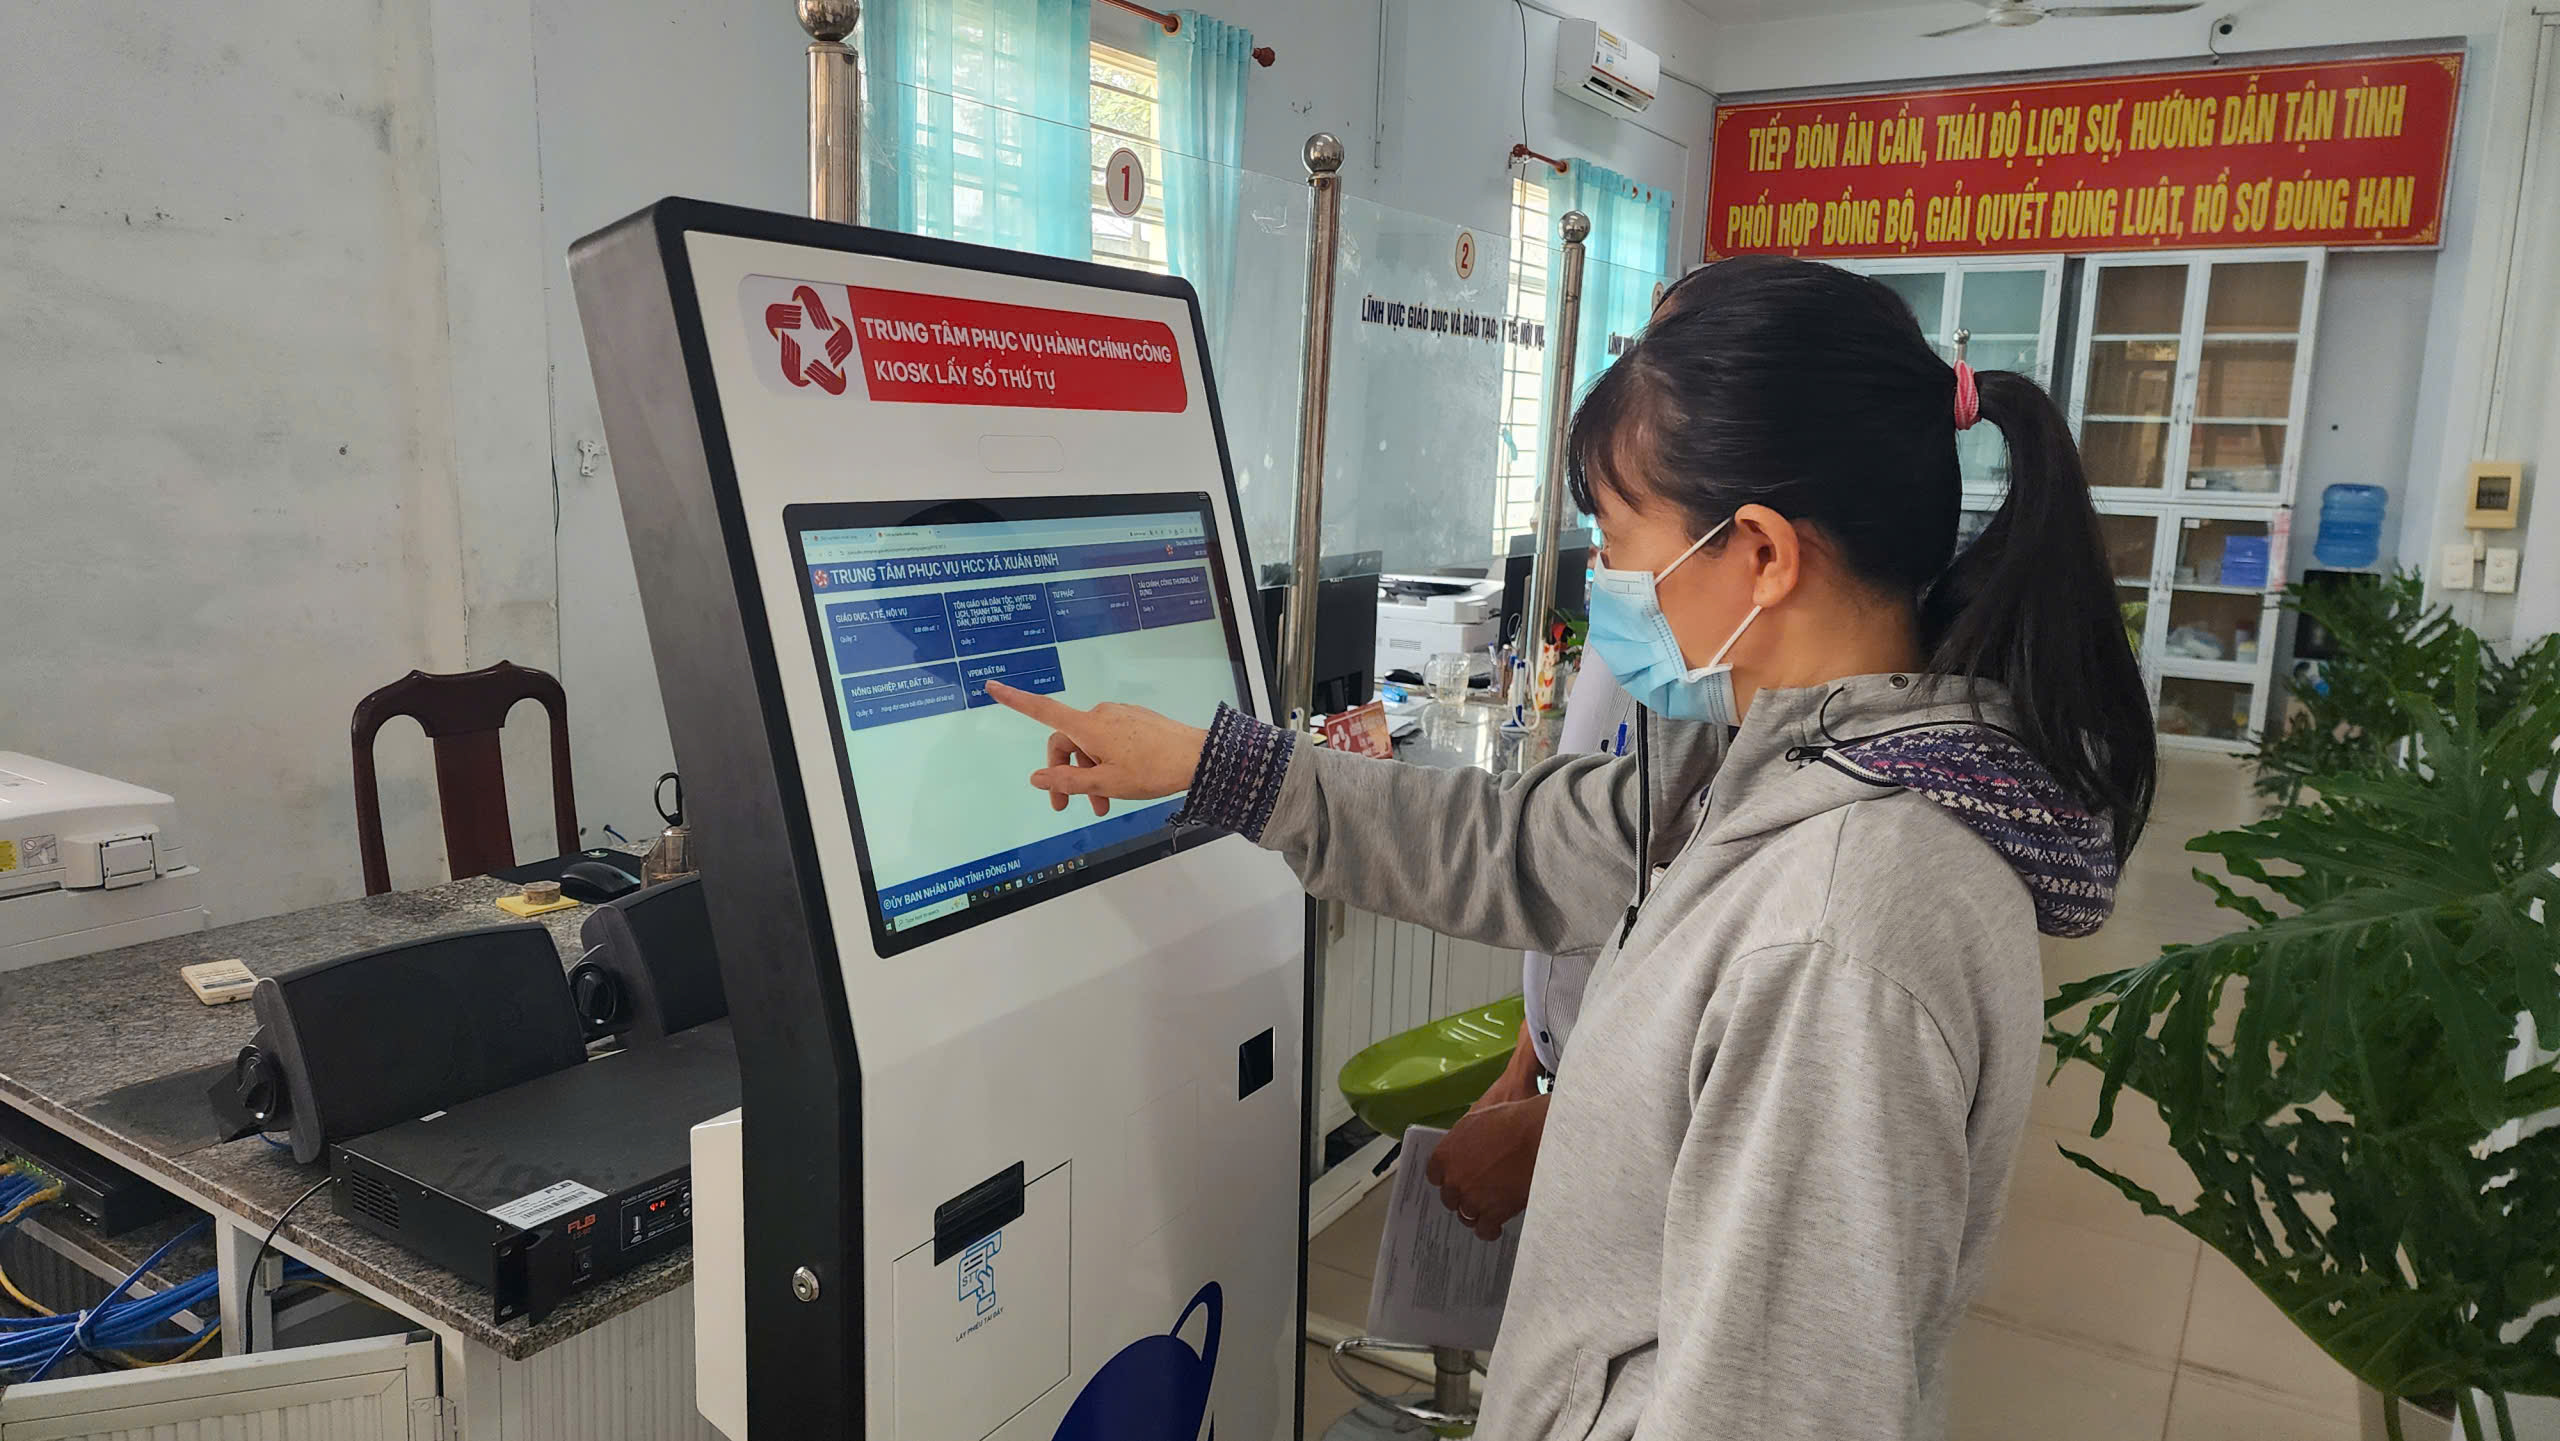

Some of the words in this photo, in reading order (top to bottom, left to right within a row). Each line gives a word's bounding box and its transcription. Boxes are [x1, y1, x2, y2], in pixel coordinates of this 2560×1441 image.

[1749, 112, 1791, 172] TIẾP
[1794, 114, 1839, 169] ĐÓN
[1842, 112, 1874, 166] ÂN
[1878, 101, 1927, 168] CẦN,
[1936, 103, 1986, 161] THÁI
[1989, 100, 2022, 168] ĐỘ
[2025, 106, 2080, 166] LỊCH
[2084, 98, 2123, 163] SỰ,
[2129, 88, 2217, 150] HƯỚNG
[2220, 75, 2278, 146] DẪN
[2284, 80, 2337, 152] TẬN
[2343, 76, 2407, 140] TÌNH
[1121, 164, 1130, 201] 1
[1726, 188, 1774, 248] PHỐI
[1777, 198, 1818, 256] HỢP
[1822, 185, 1880, 246] ĐỒNG
[1884, 188, 1918, 253] BỘ,
[1925, 180, 1971, 242] GIẢI
[1976, 176, 2048, 246] QUYẾT
[2050, 180, 2118, 238] ĐÚNG
[2121, 176, 2184, 246] LUẬT,
[2192, 167, 2230, 234] HỒ
[2232, 178, 2272, 232] SƠ
[2274, 169, 2350, 232] ĐÚNG
[2354, 176, 2415, 240] HẠN
[1462, 242, 1469, 269] 2
[860, 317, 929, 344] TRUNG
[930, 320, 970, 347] TÂM
[971, 328, 1018, 356] PHỤC
[1019, 332, 1042, 358] VỤ
[1044, 331, 1087, 356] HÀNH
[1088, 336, 1132, 360] CHÍNH
[1133, 340, 1172, 363] CÔNG
[1362, 294, 1384, 324] LĨNH
[1387, 301, 1406, 332] VỰC
[1408, 302, 1428, 330] GIÁO
[1430, 310, 1448, 337] DỤC
[1450, 308, 1460, 334] VÀ
[1463, 310, 1480, 336] ĐÀO
[1502, 320, 1506, 342] Y
[1520, 319, 1533, 350] NỘI
[874, 360, 933, 384] KIOSK
[935, 356, 967, 385] LẤY
[972, 359, 996, 387] SỐ
[998, 364, 1032, 389] THỨ
[1033, 370, 1056, 394] TỰ
[830, 567, 876, 584] TRUNG
[877, 562, 906, 581] TÂM
[908, 562, 941, 580] PHỤC
[942, 560, 960, 578] VỤ
[961, 559, 985, 574] HCC
[986, 554, 1002, 572] XÃ
[1004, 553, 1032, 570] XUÂN
[1034, 553, 1059, 570] ĐỊNH
[836, 611, 852, 623] GIÁO
[853, 612, 870, 622] DỤC,
[870, 611, 876, 620] Y
[886, 608, 898, 620] NỘI
[899, 608, 908, 617] VỤ
[851, 686, 872, 697] NÔNG
[872, 682, 898, 693] NGHIỆP,
[909, 676, 922, 688] ĐẤT
[922, 677, 934, 686] ĐAI
[984, 666, 995, 675] ĐẤT
[996, 665, 1006, 674] ĐAI
[904, 890, 922, 904] BAN
[923, 883, 948, 899] NHÂN
[948, 876, 965, 892] DÂN
[966, 871, 985, 886] TỈNH
[986, 864, 1007, 880] ĐỒNG
[1007, 859, 1021, 872] NAI
